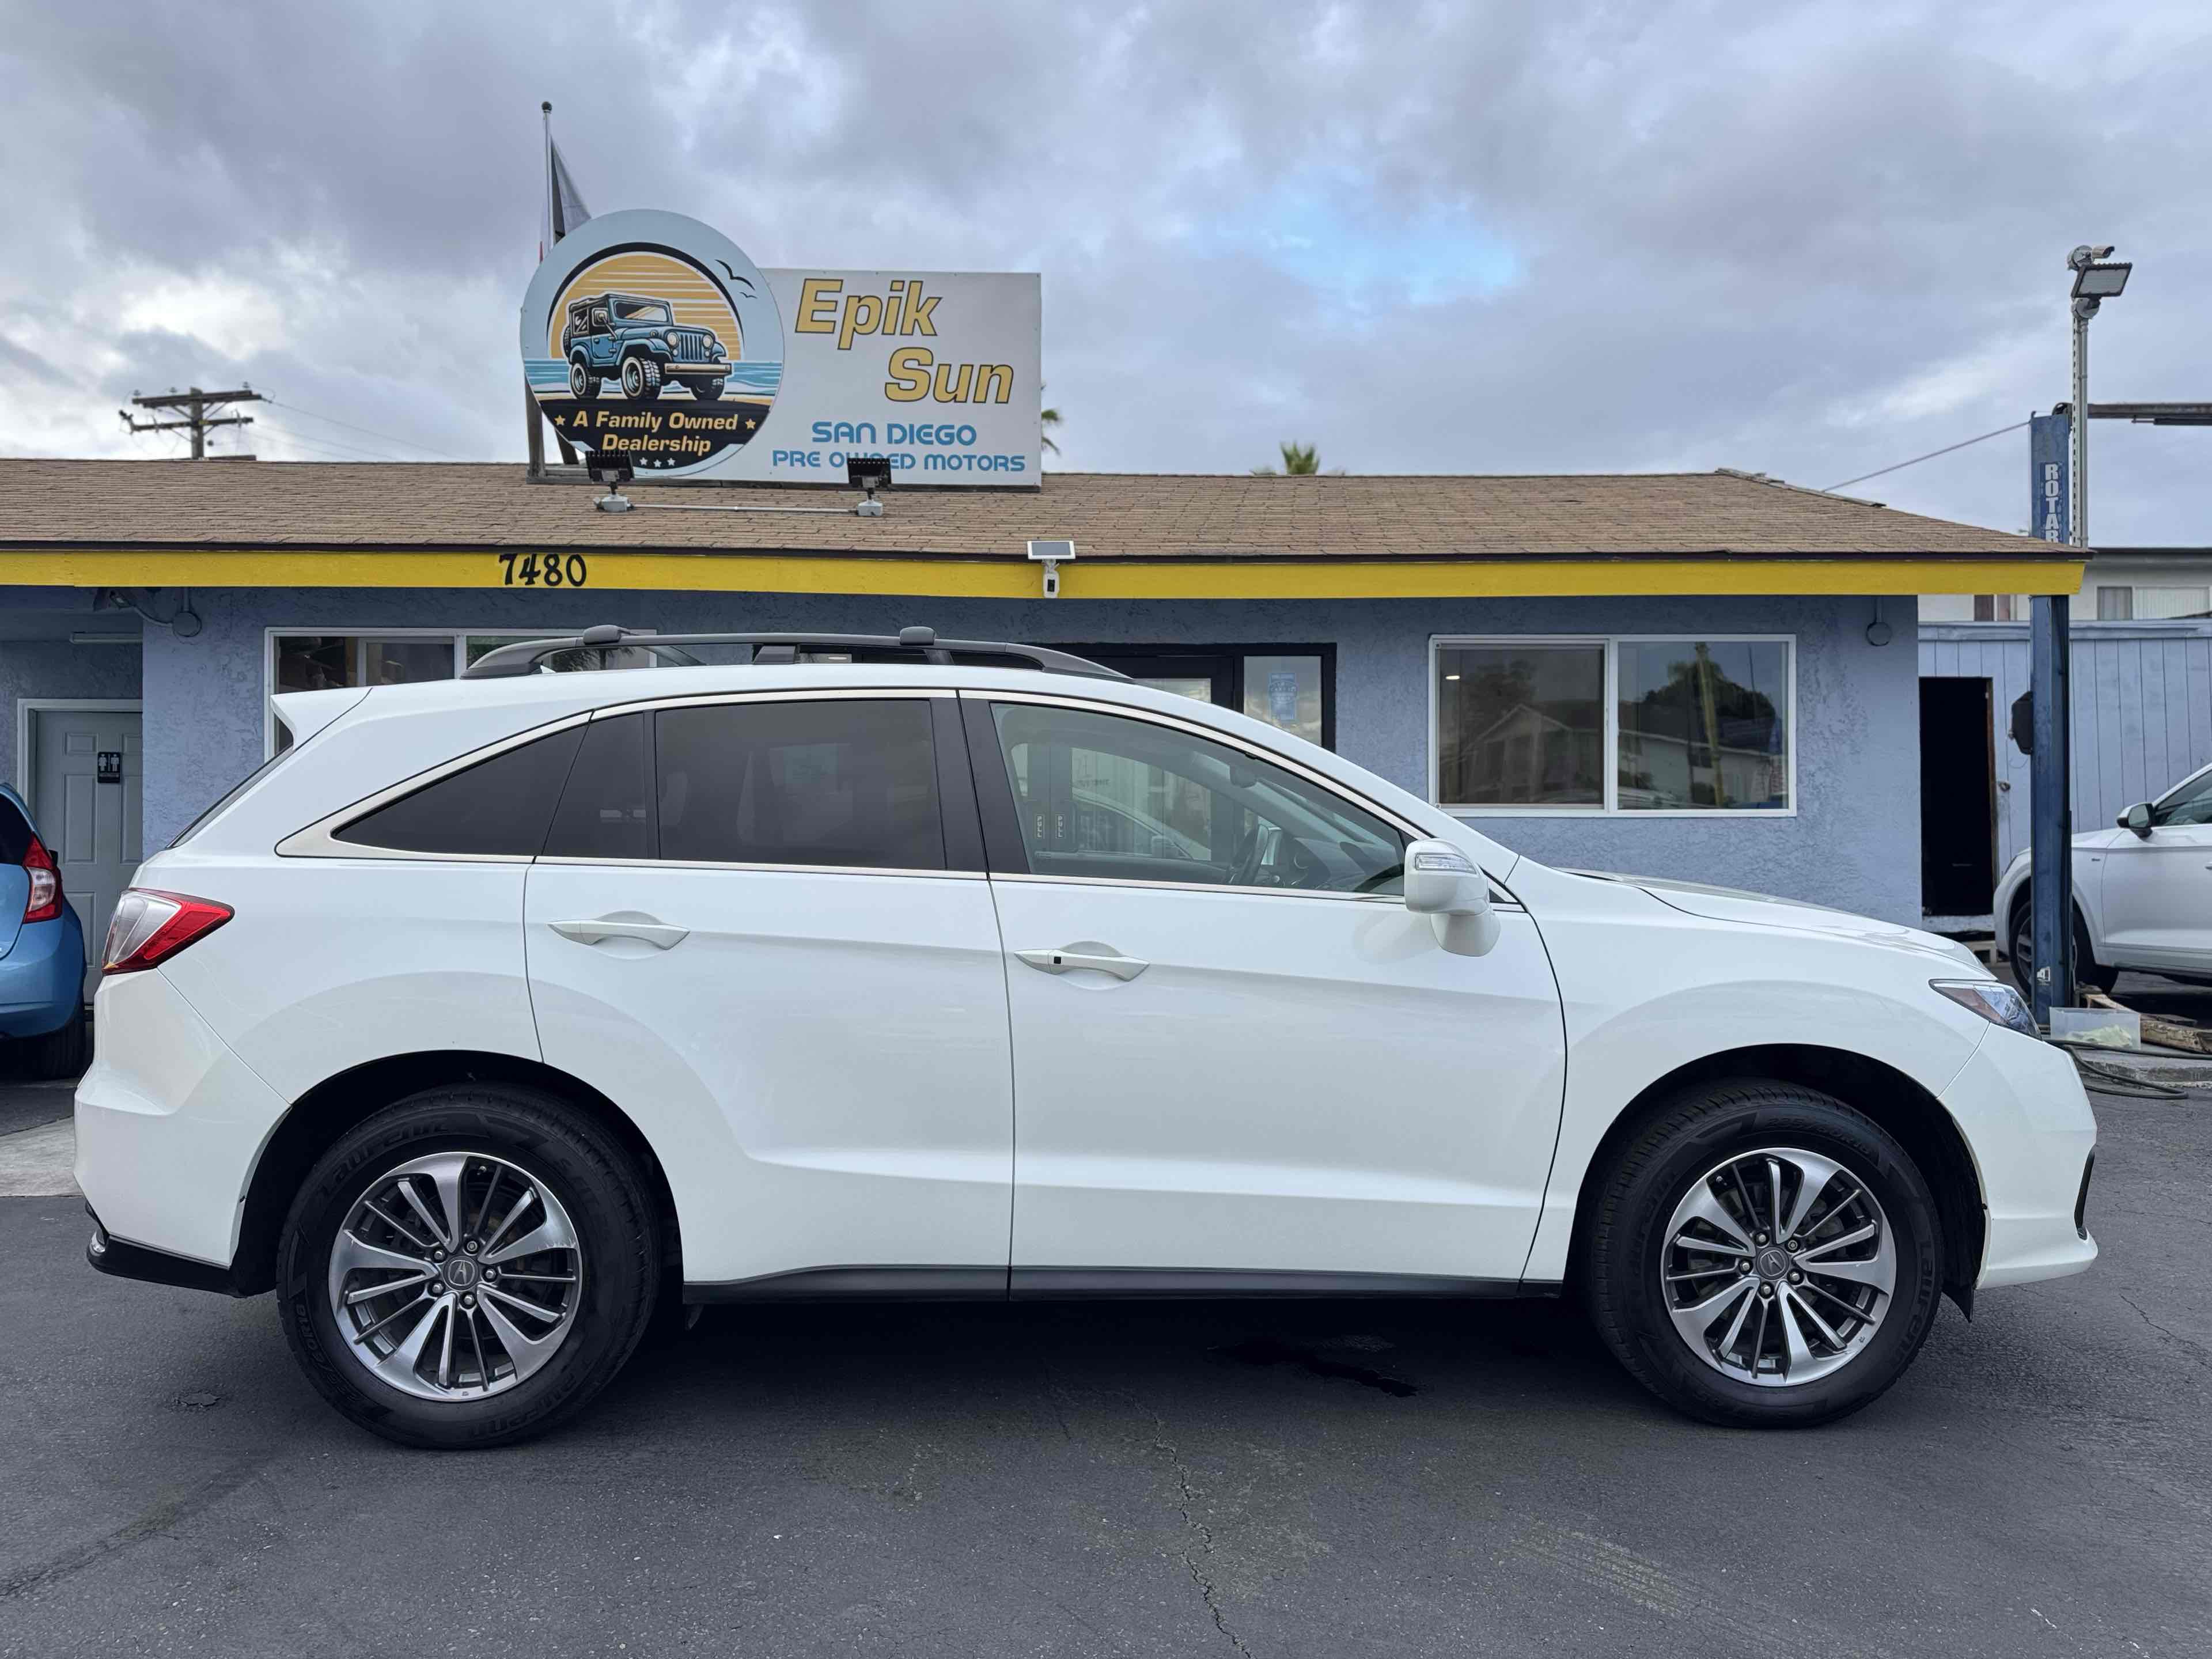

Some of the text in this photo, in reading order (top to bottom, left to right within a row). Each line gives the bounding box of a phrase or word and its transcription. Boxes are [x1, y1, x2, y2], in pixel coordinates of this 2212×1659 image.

[795, 278, 942, 350] Epik
[885, 347, 1014, 403] Sun
[572, 410, 738, 433] A Family Owned
[602, 434, 711, 456] Dealership
[812, 422, 977, 446] SAN DIEGO
[772, 450, 821, 467] PRE
[924, 454, 1025, 472] MOTORS
[499, 553, 586, 586] 7480
